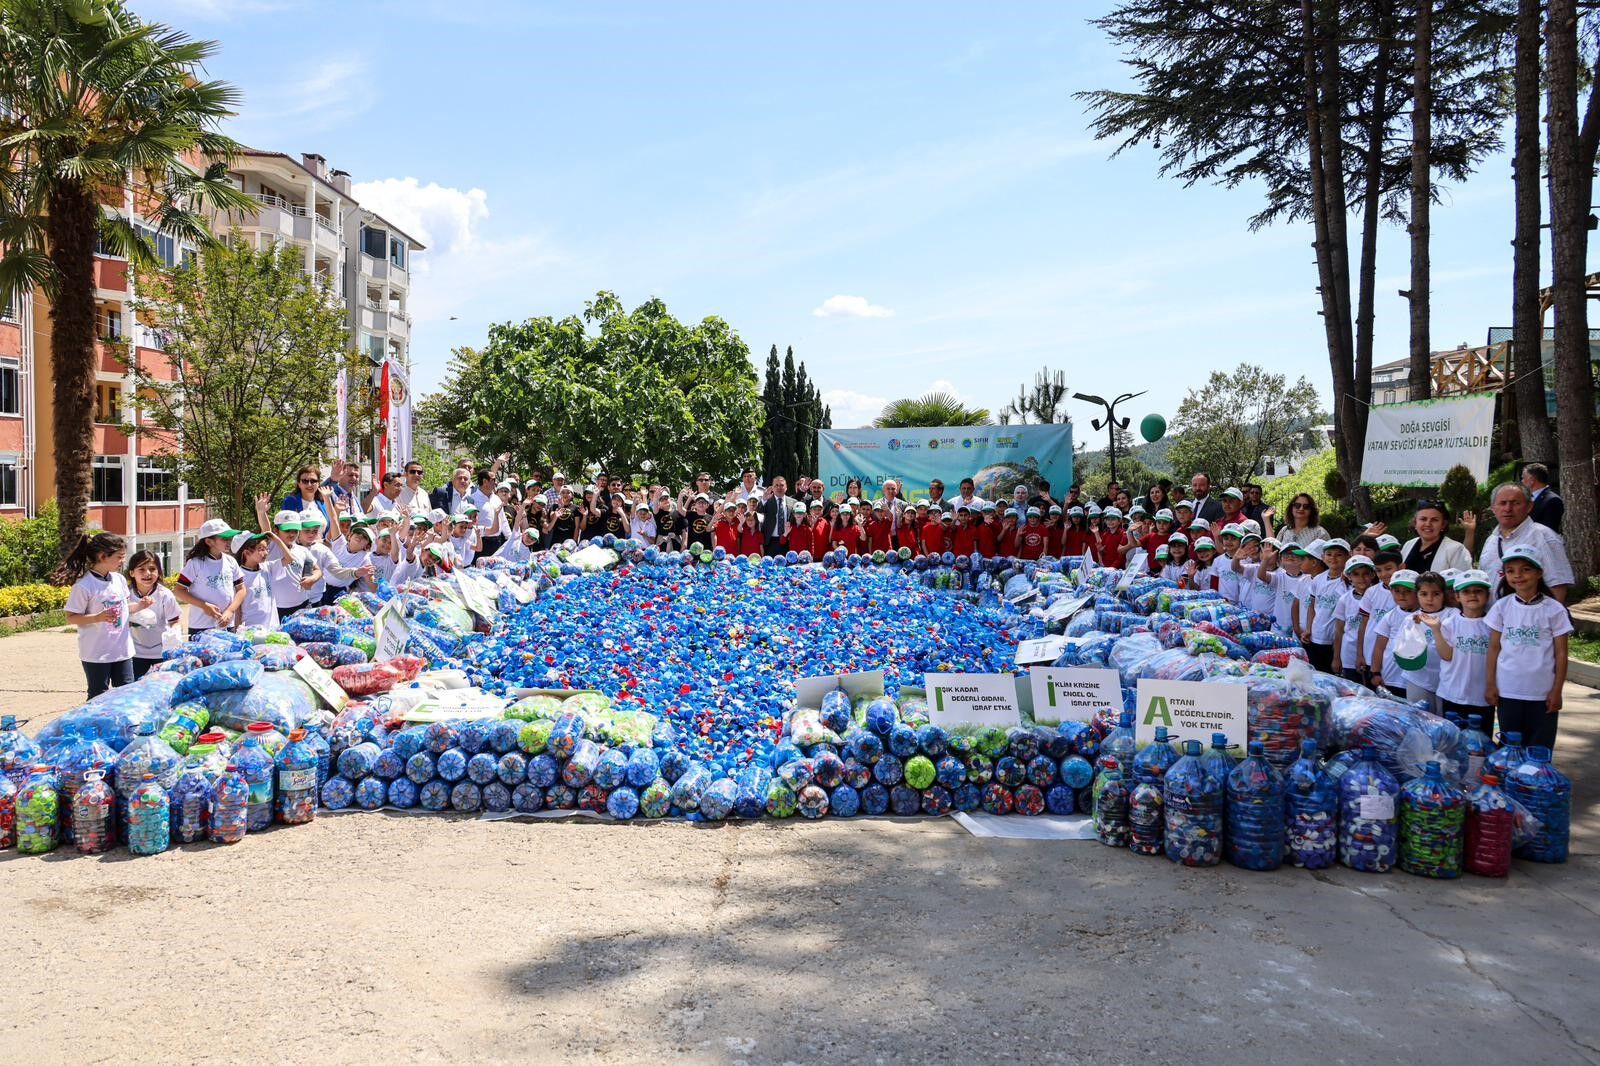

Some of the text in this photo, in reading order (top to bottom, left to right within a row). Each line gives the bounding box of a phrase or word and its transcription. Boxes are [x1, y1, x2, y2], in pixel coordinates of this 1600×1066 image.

[1400, 418, 1450, 433] DOĞA SEVGİSİ
[1367, 440, 1389, 450] VATAN
[1390, 437, 1417, 450] SEVGİSİ
[1417, 438, 1443, 449] KADAR
[1073, 681, 1100, 689] KRİZİNE
[1180, 720, 1223, 730] YOK ETME
